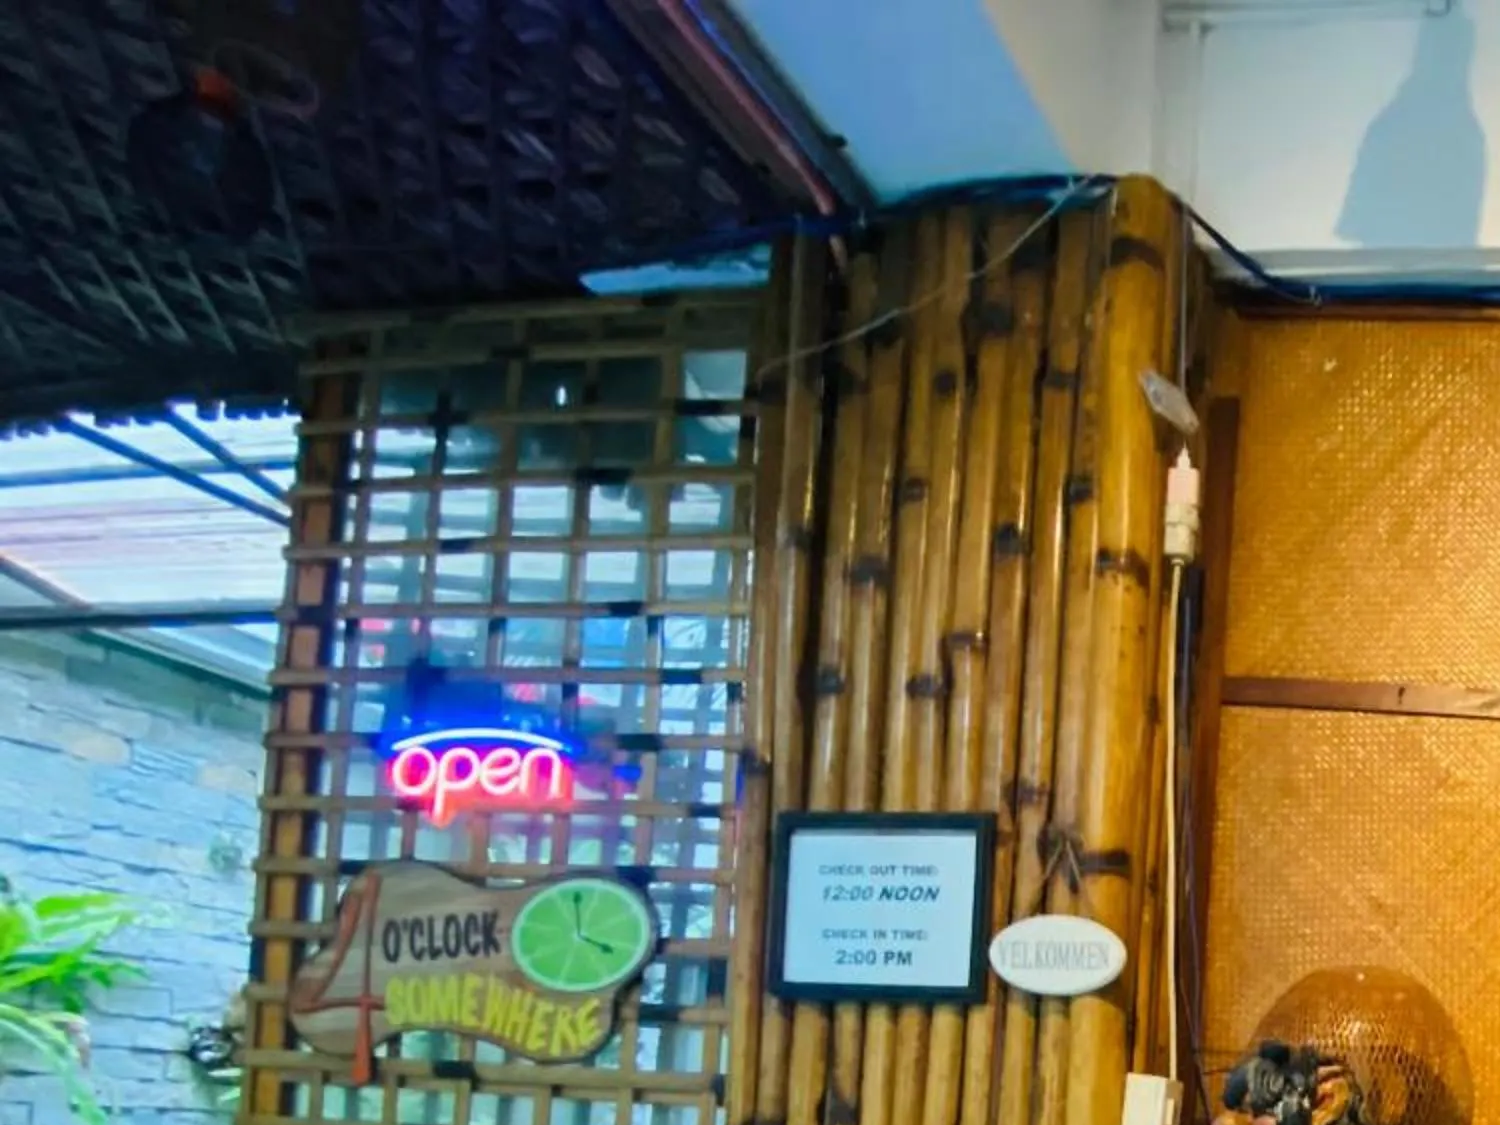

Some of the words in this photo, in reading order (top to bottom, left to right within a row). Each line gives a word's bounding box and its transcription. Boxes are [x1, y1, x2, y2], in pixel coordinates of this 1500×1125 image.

[392, 746, 563, 818] open
[818, 864, 864, 876] CHECK
[869, 864, 897, 877] OUT
[822, 885, 874, 902] 12:00
[879, 885, 941, 902] NOON
[382, 909, 501, 963] O'CLOCK
[821, 928, 867, 940] CHECK
[873, 929, 888, 940] IN
[834, 949, 877, 966] 2:00
[883, 949, 913, 967] PM
[998, 939, 1111, 971] VELKOMMEN
[384, 973, 603, 1057] SOMEWHERE
